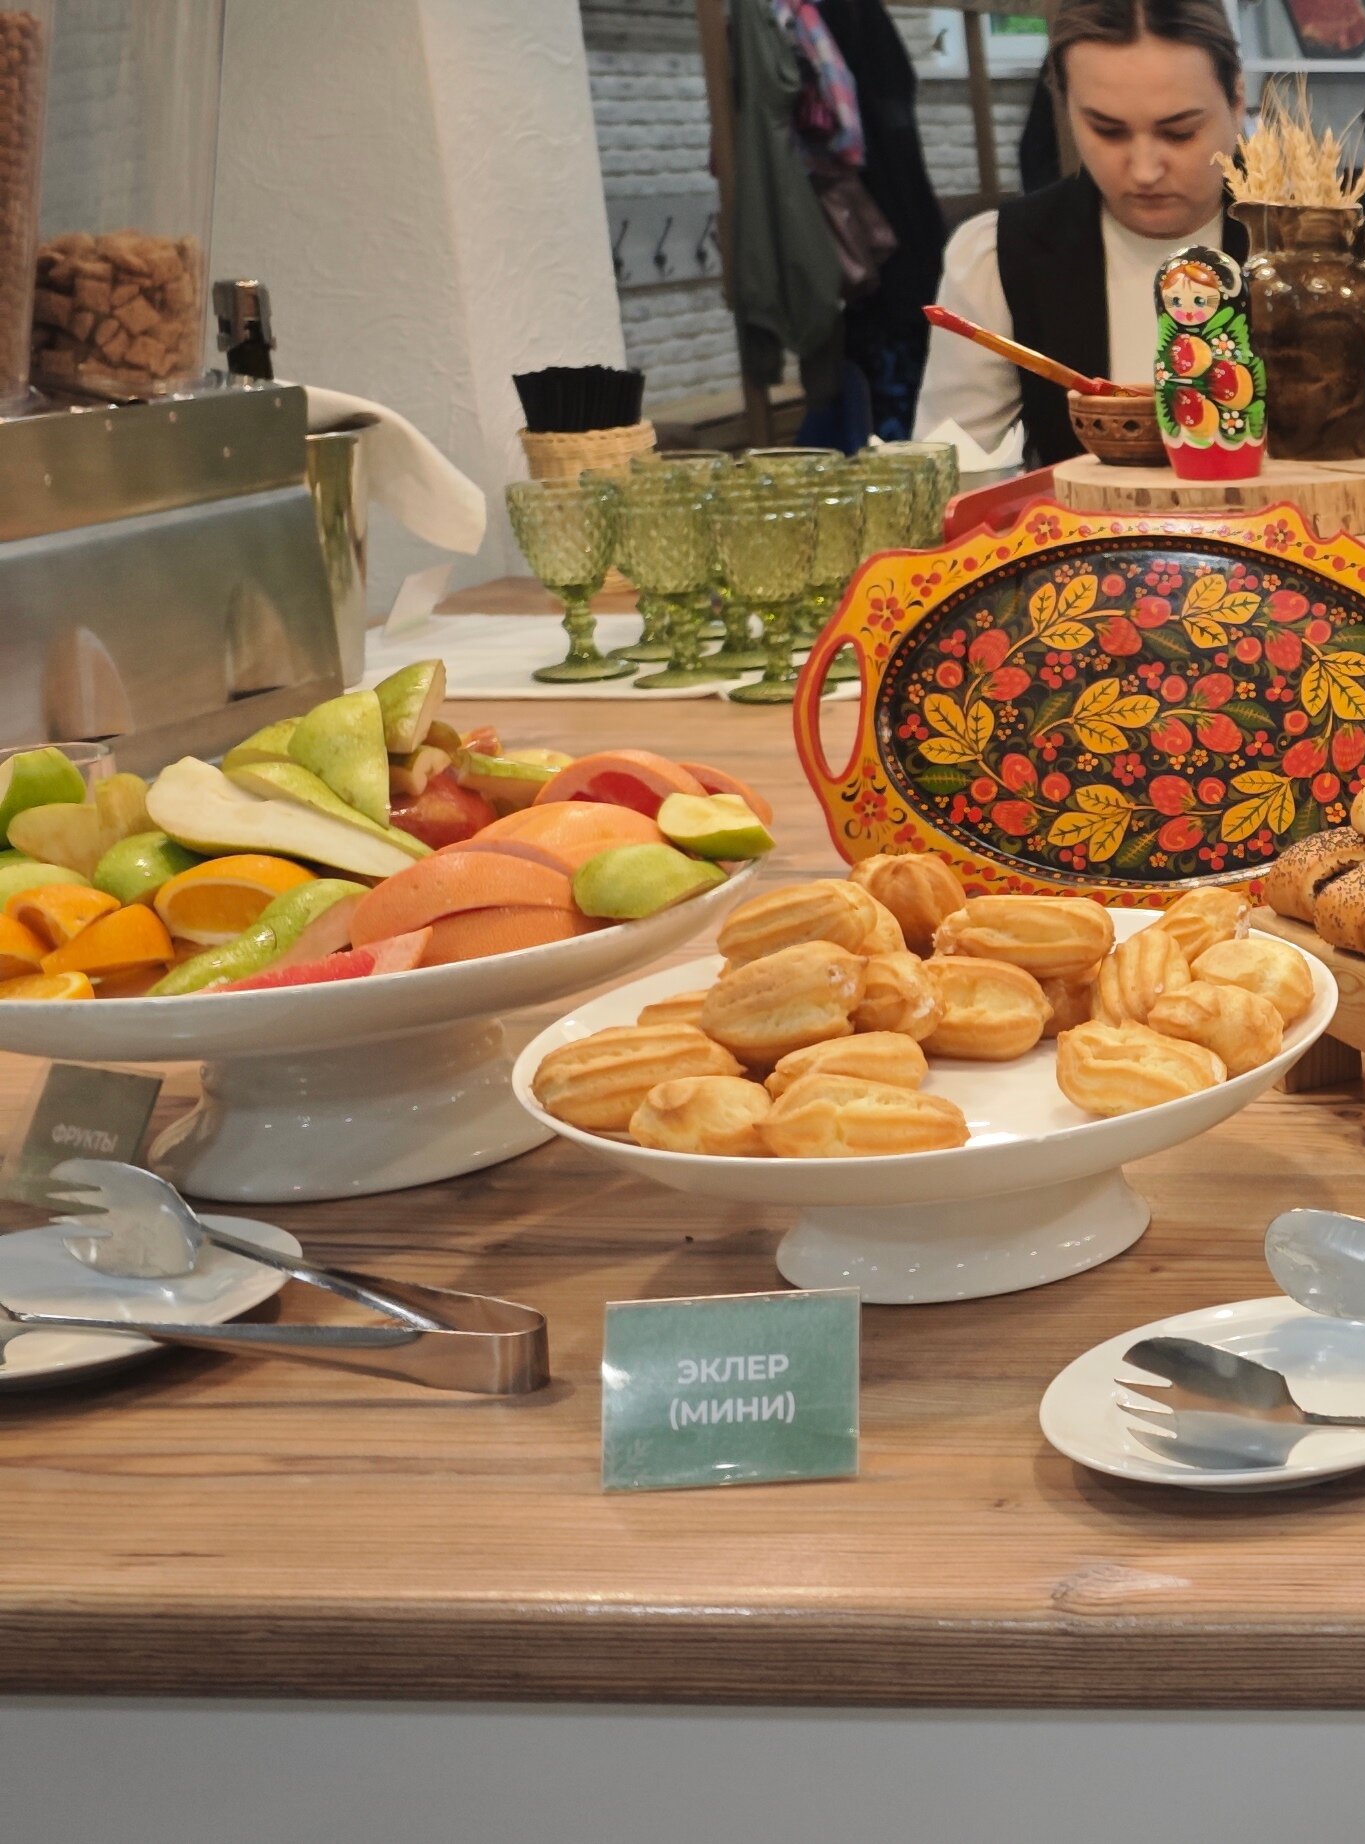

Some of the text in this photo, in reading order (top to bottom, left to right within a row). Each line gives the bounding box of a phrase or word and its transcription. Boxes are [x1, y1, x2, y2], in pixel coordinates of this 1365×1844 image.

[51, 1122, 119, 1153] ФРУКТЫ
[677, 1353, 790, 1385] ЭКЛЕР
[669, 1390, 796, 1431] (МИНИ)
